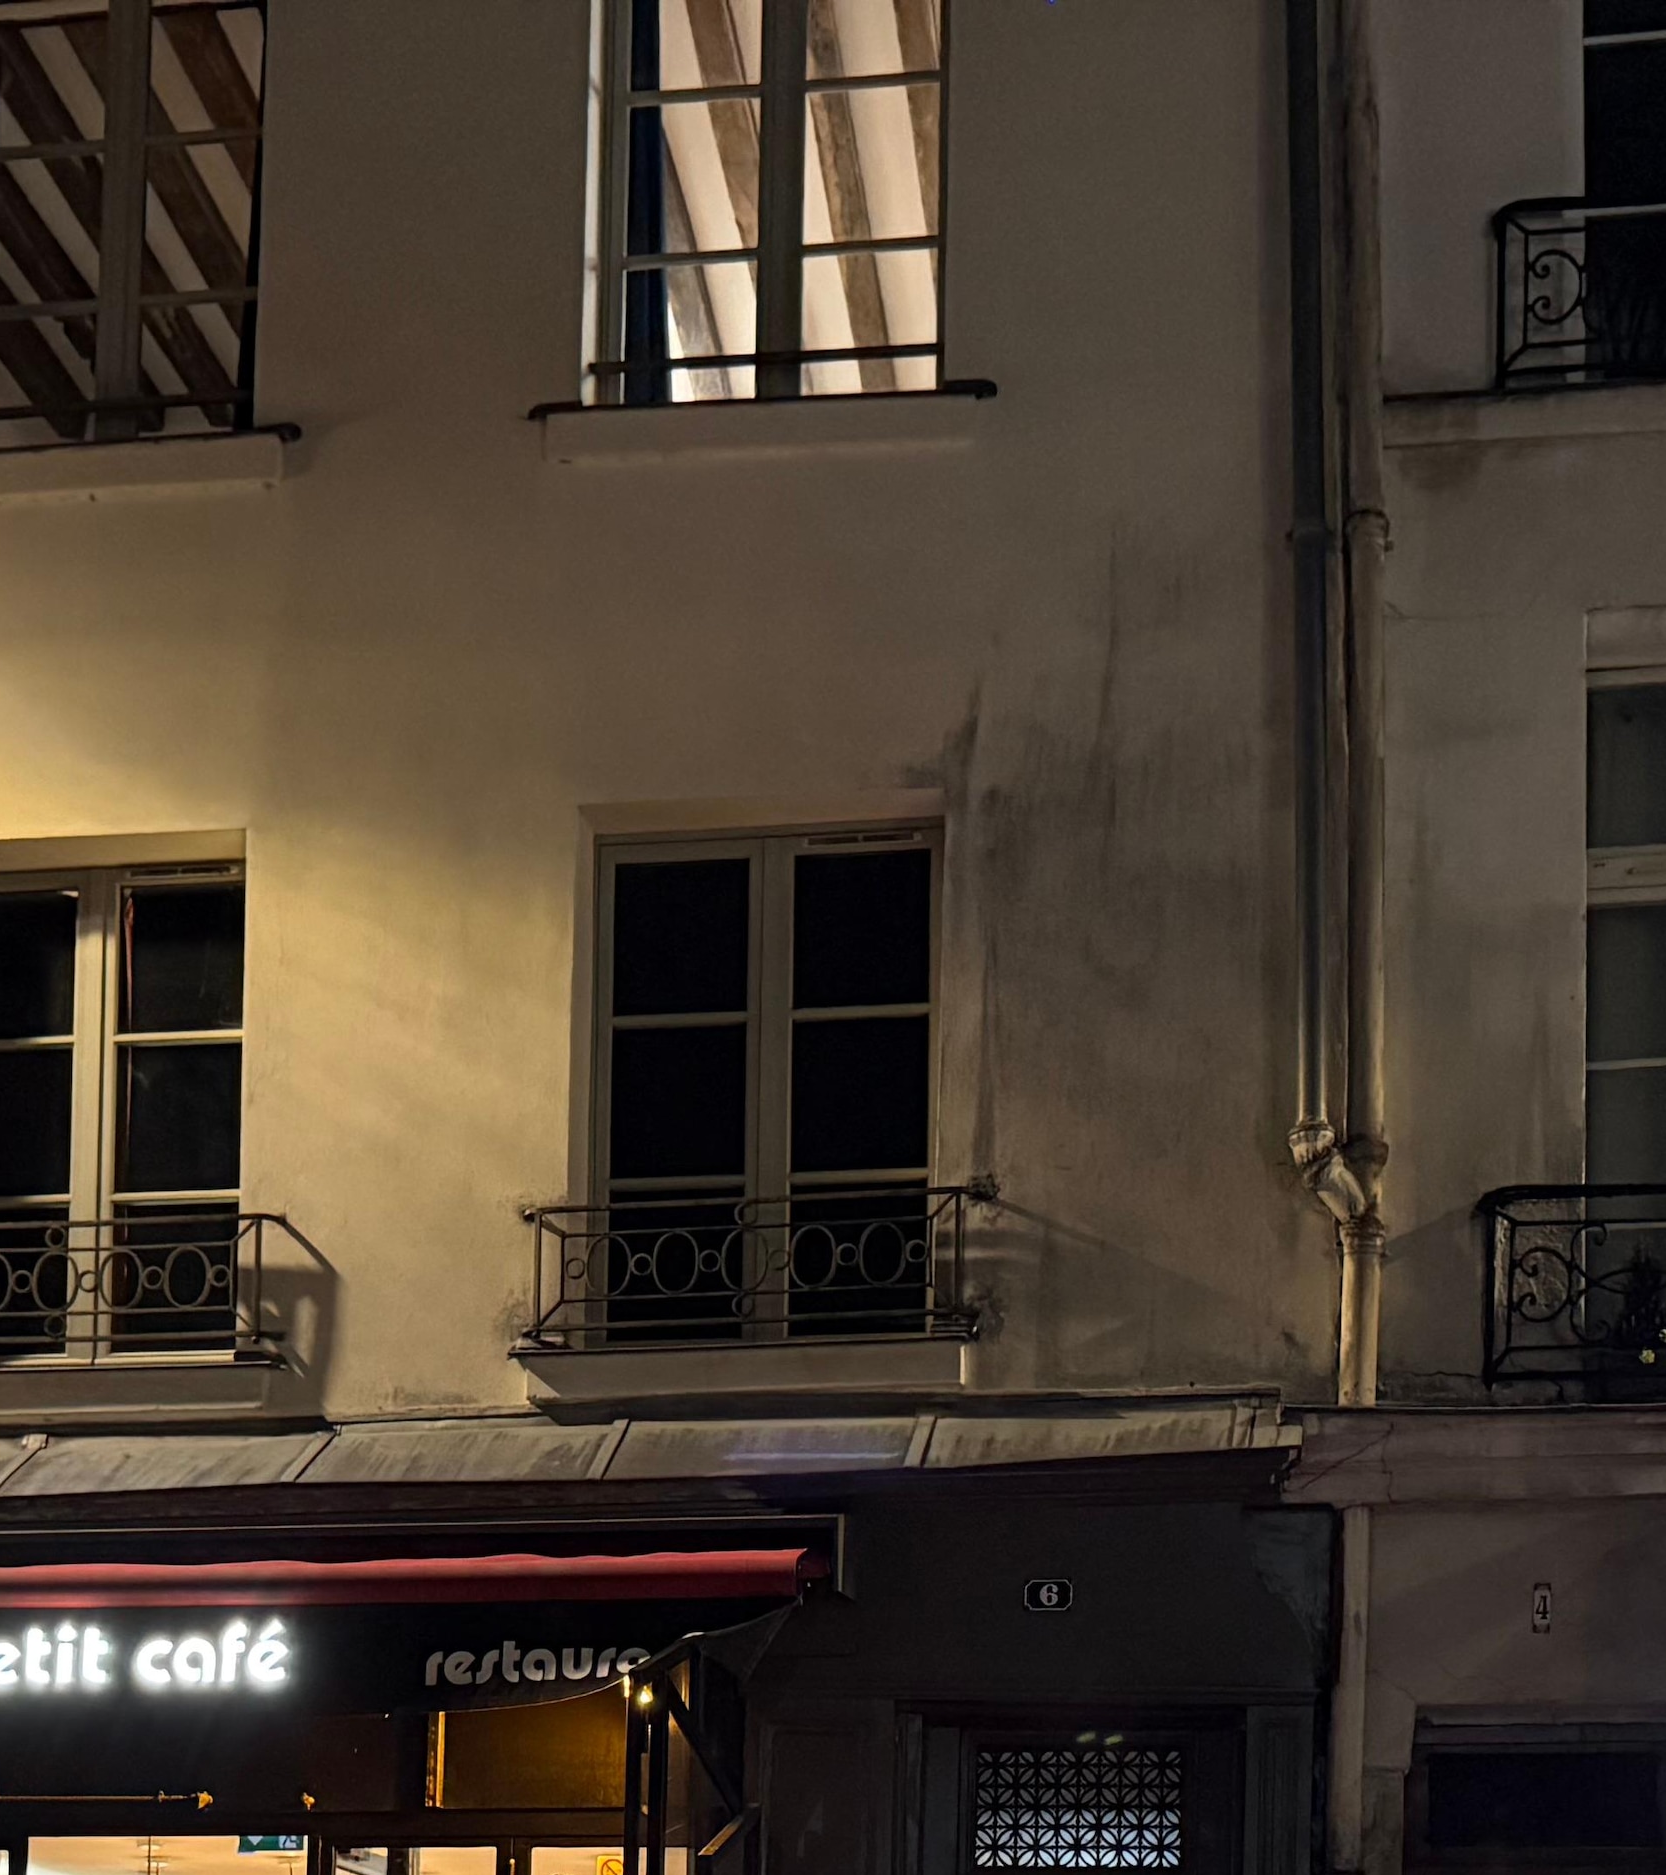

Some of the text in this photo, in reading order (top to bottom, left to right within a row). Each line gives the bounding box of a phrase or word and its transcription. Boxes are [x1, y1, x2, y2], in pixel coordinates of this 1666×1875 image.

[1039, 1584, 1058, 1606] 6
[1536, 1595, 1549, 1620] 4
[135, 1617, 290, 1687] café
